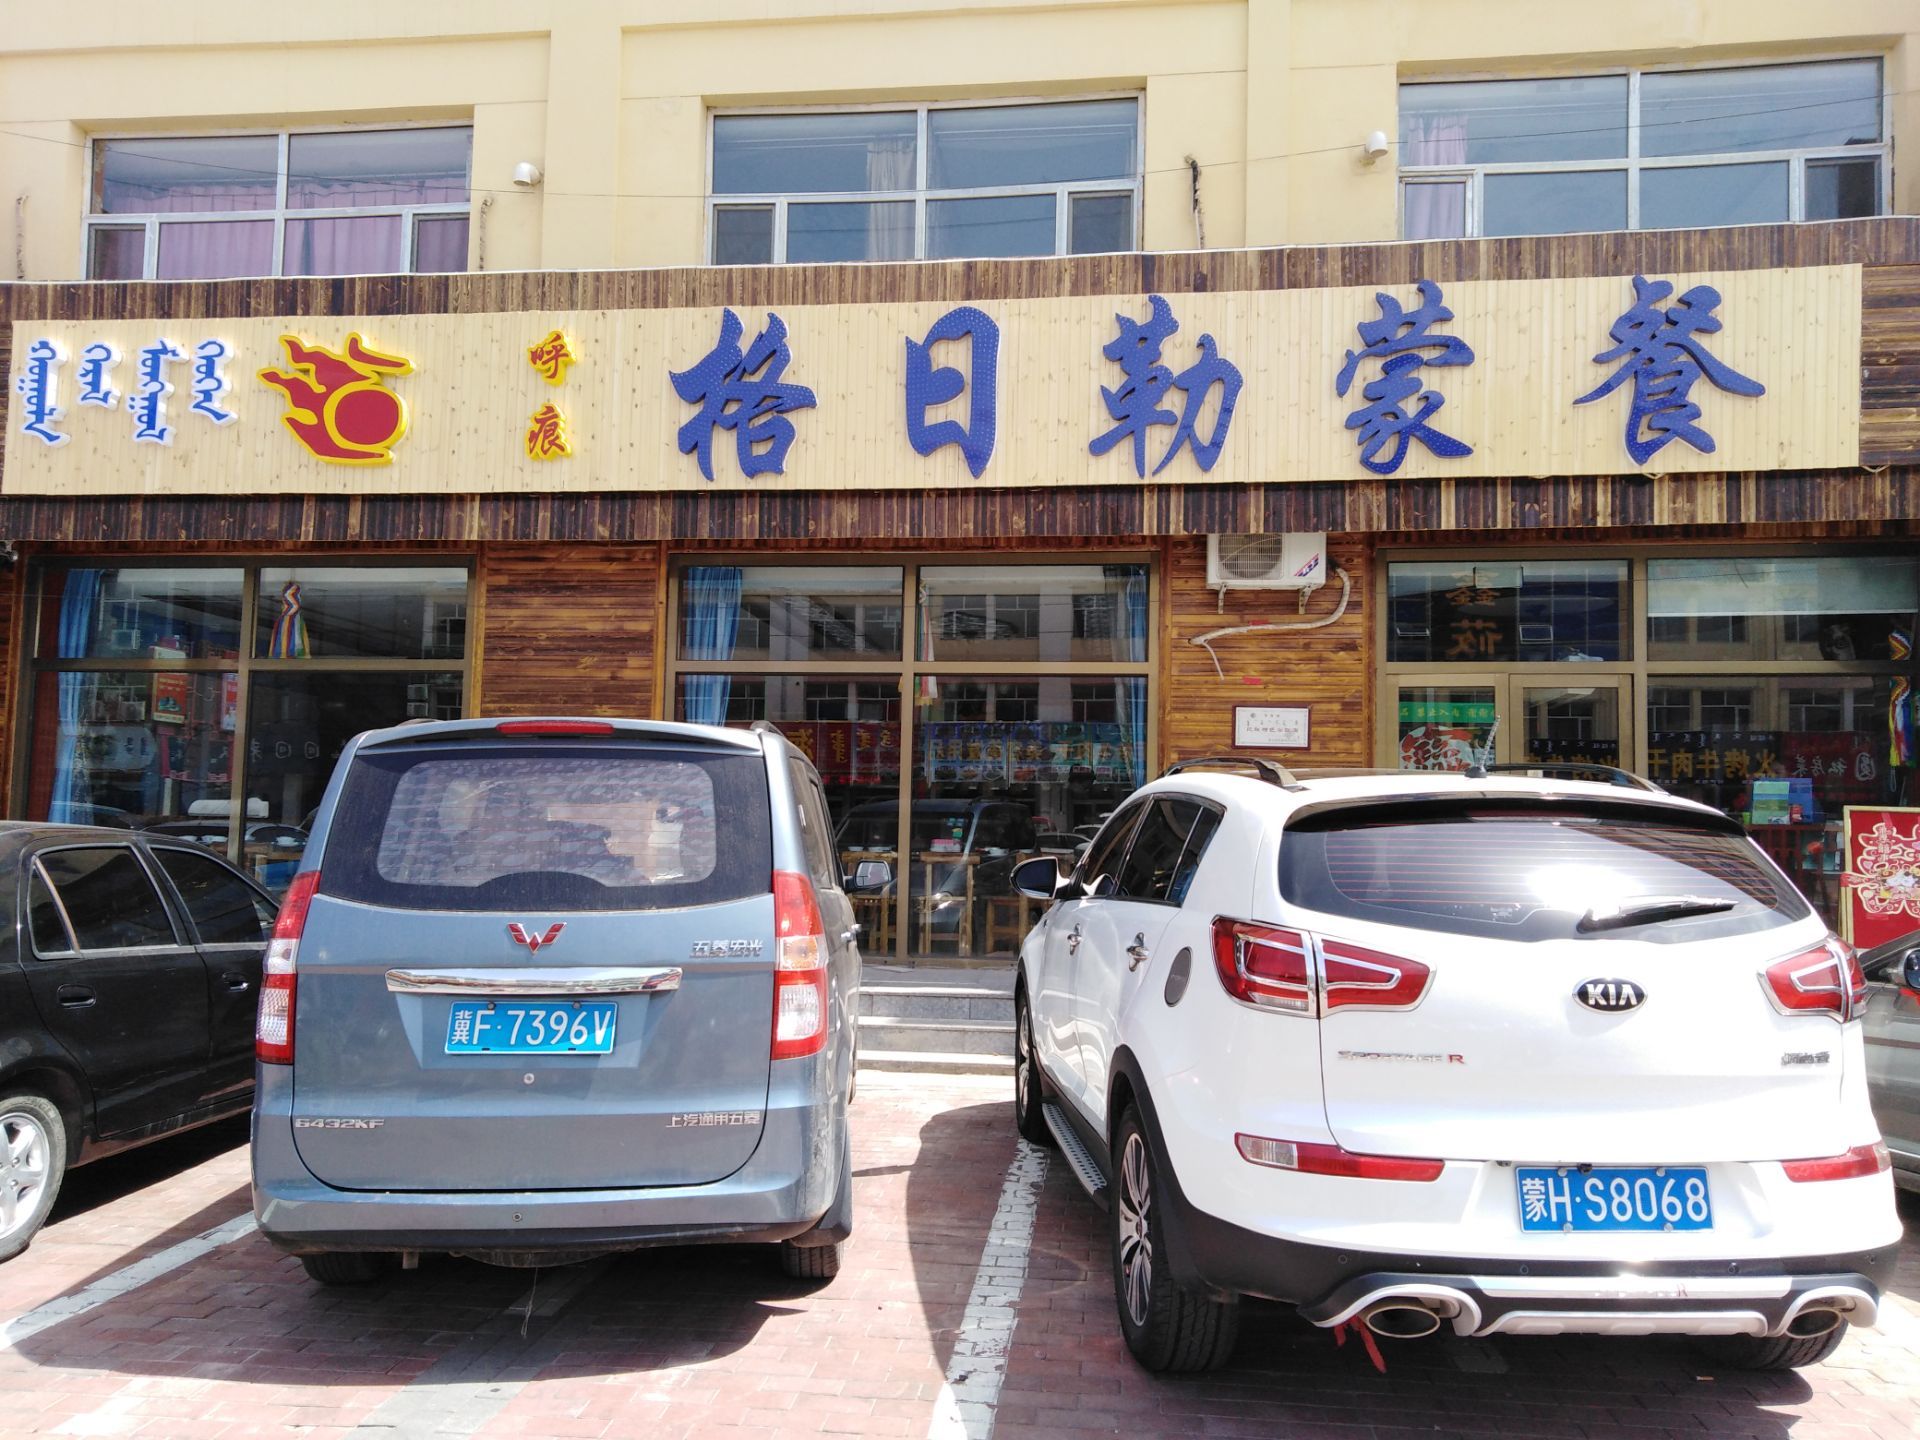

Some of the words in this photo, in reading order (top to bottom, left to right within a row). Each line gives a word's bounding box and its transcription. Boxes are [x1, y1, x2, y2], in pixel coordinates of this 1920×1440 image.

[669, 274, 1766, 482] 格日勒蒙餐
[528, 333, 570, 456] 呼痕
[690, 940, 763, 959] 五菱宏光
[1585, 983, 1638, 1006] KIA
[451, 1009, 612, 1046] 冀F·7396V
[1448, 1054, 1464, 1063] R
[295, 1118, 385, 1129] 6432KF
[665, 1111, 760, 1128] 上汽通用五菱
[1521, 1177, 1708, 1223] 蒙H·S8068
